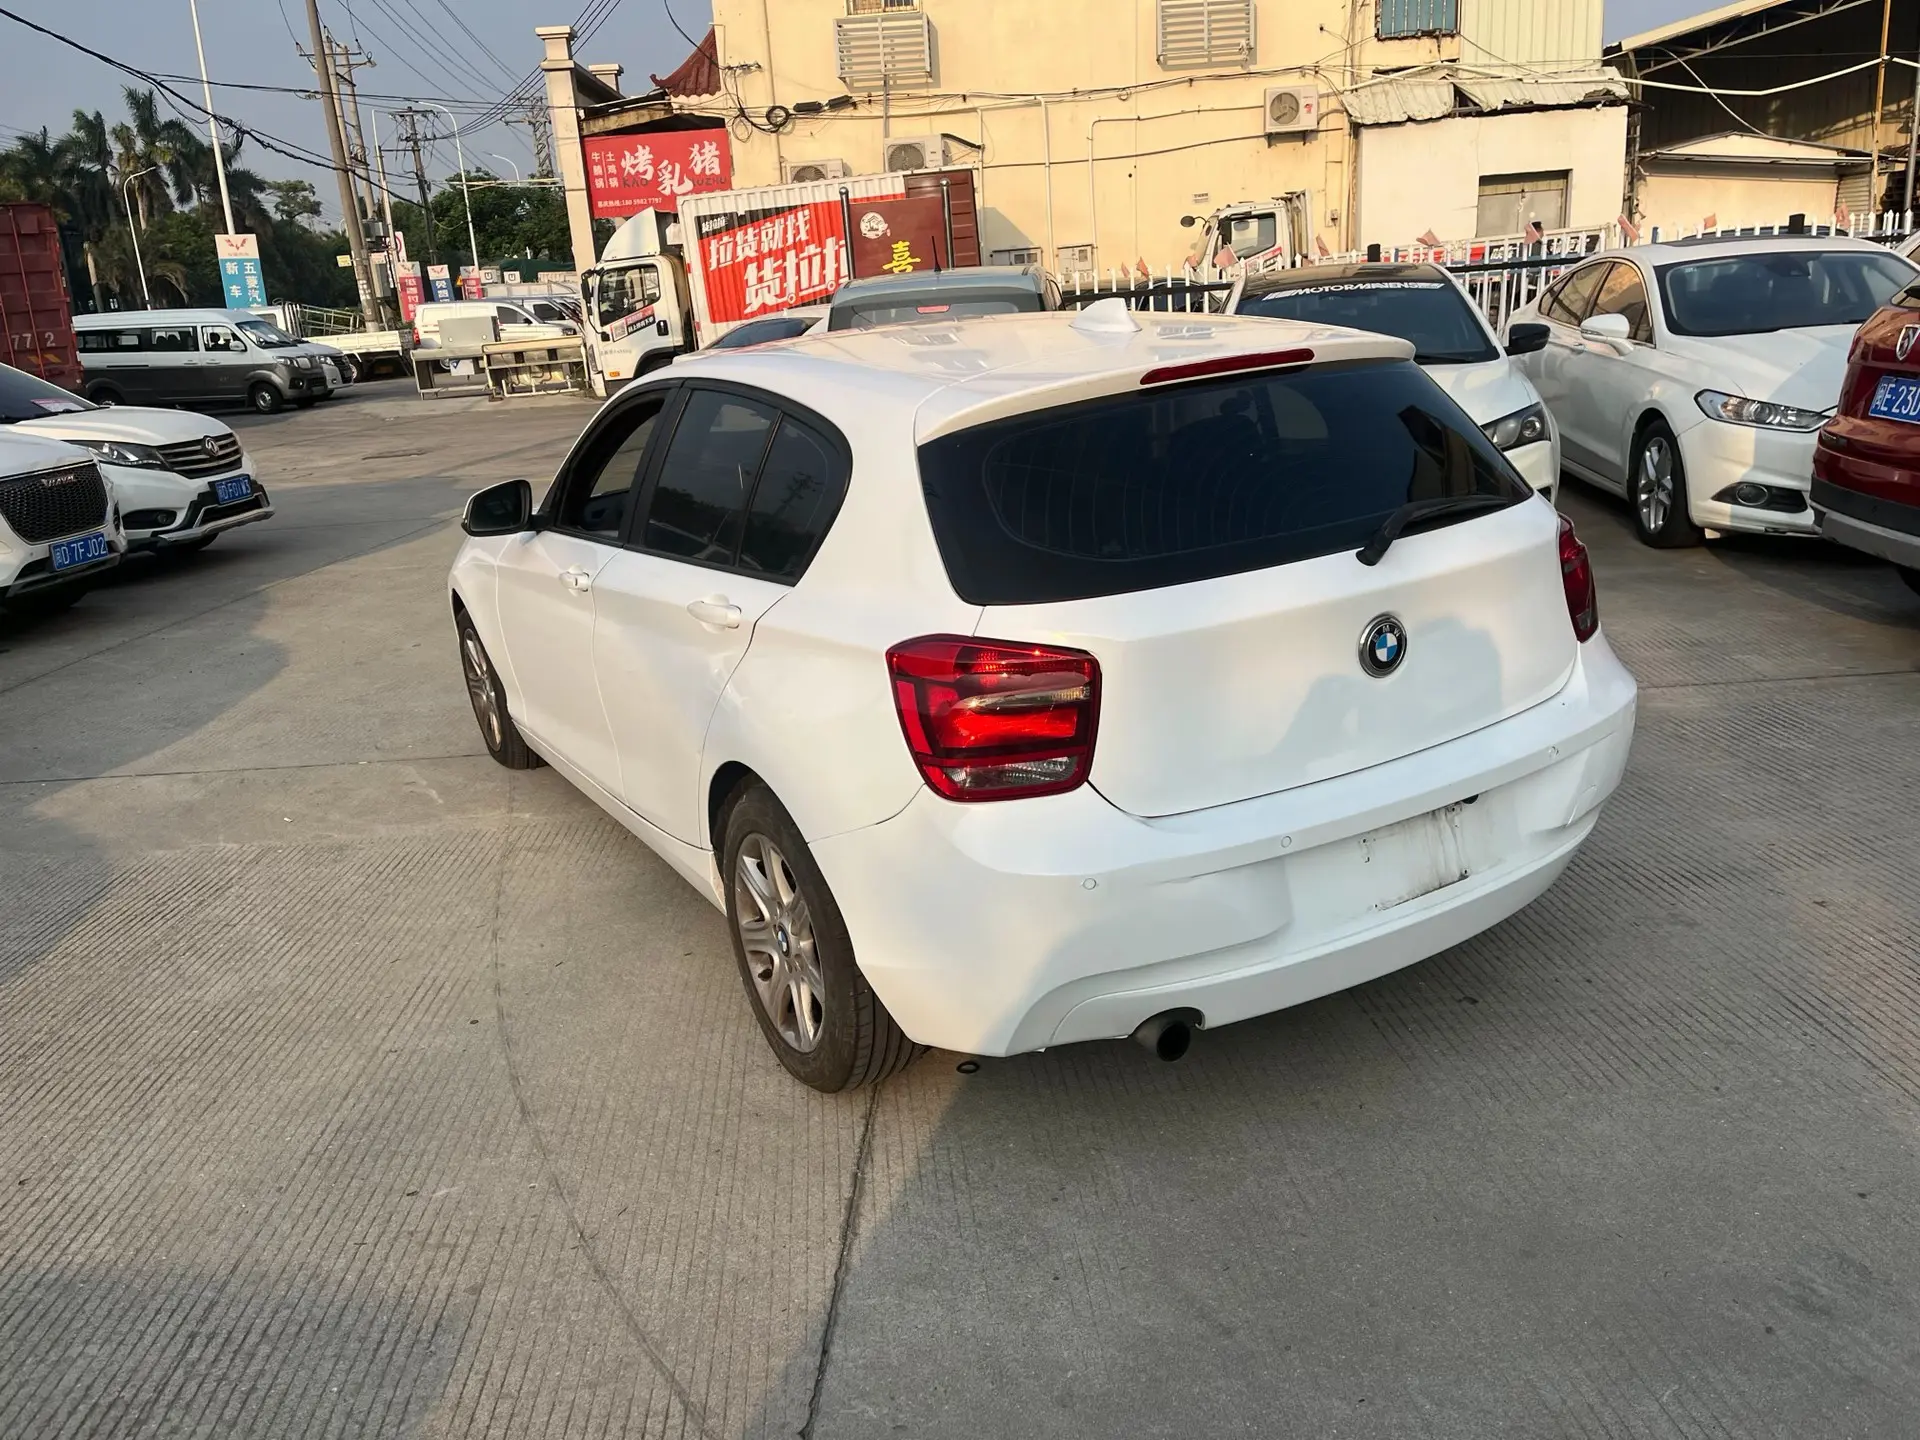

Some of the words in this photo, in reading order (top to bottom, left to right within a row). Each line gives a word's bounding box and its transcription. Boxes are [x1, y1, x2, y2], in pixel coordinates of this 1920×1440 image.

[621, 141, 721, 196] 烤乳猪
[692, 176, 727, 187] UZHU
[709, 209, 811, 272] 拉货就找
[882, 240, 921, 273] 喜
[225, 262, 243, 298] 新车
[1372, 624, 1401, 643] BMW
